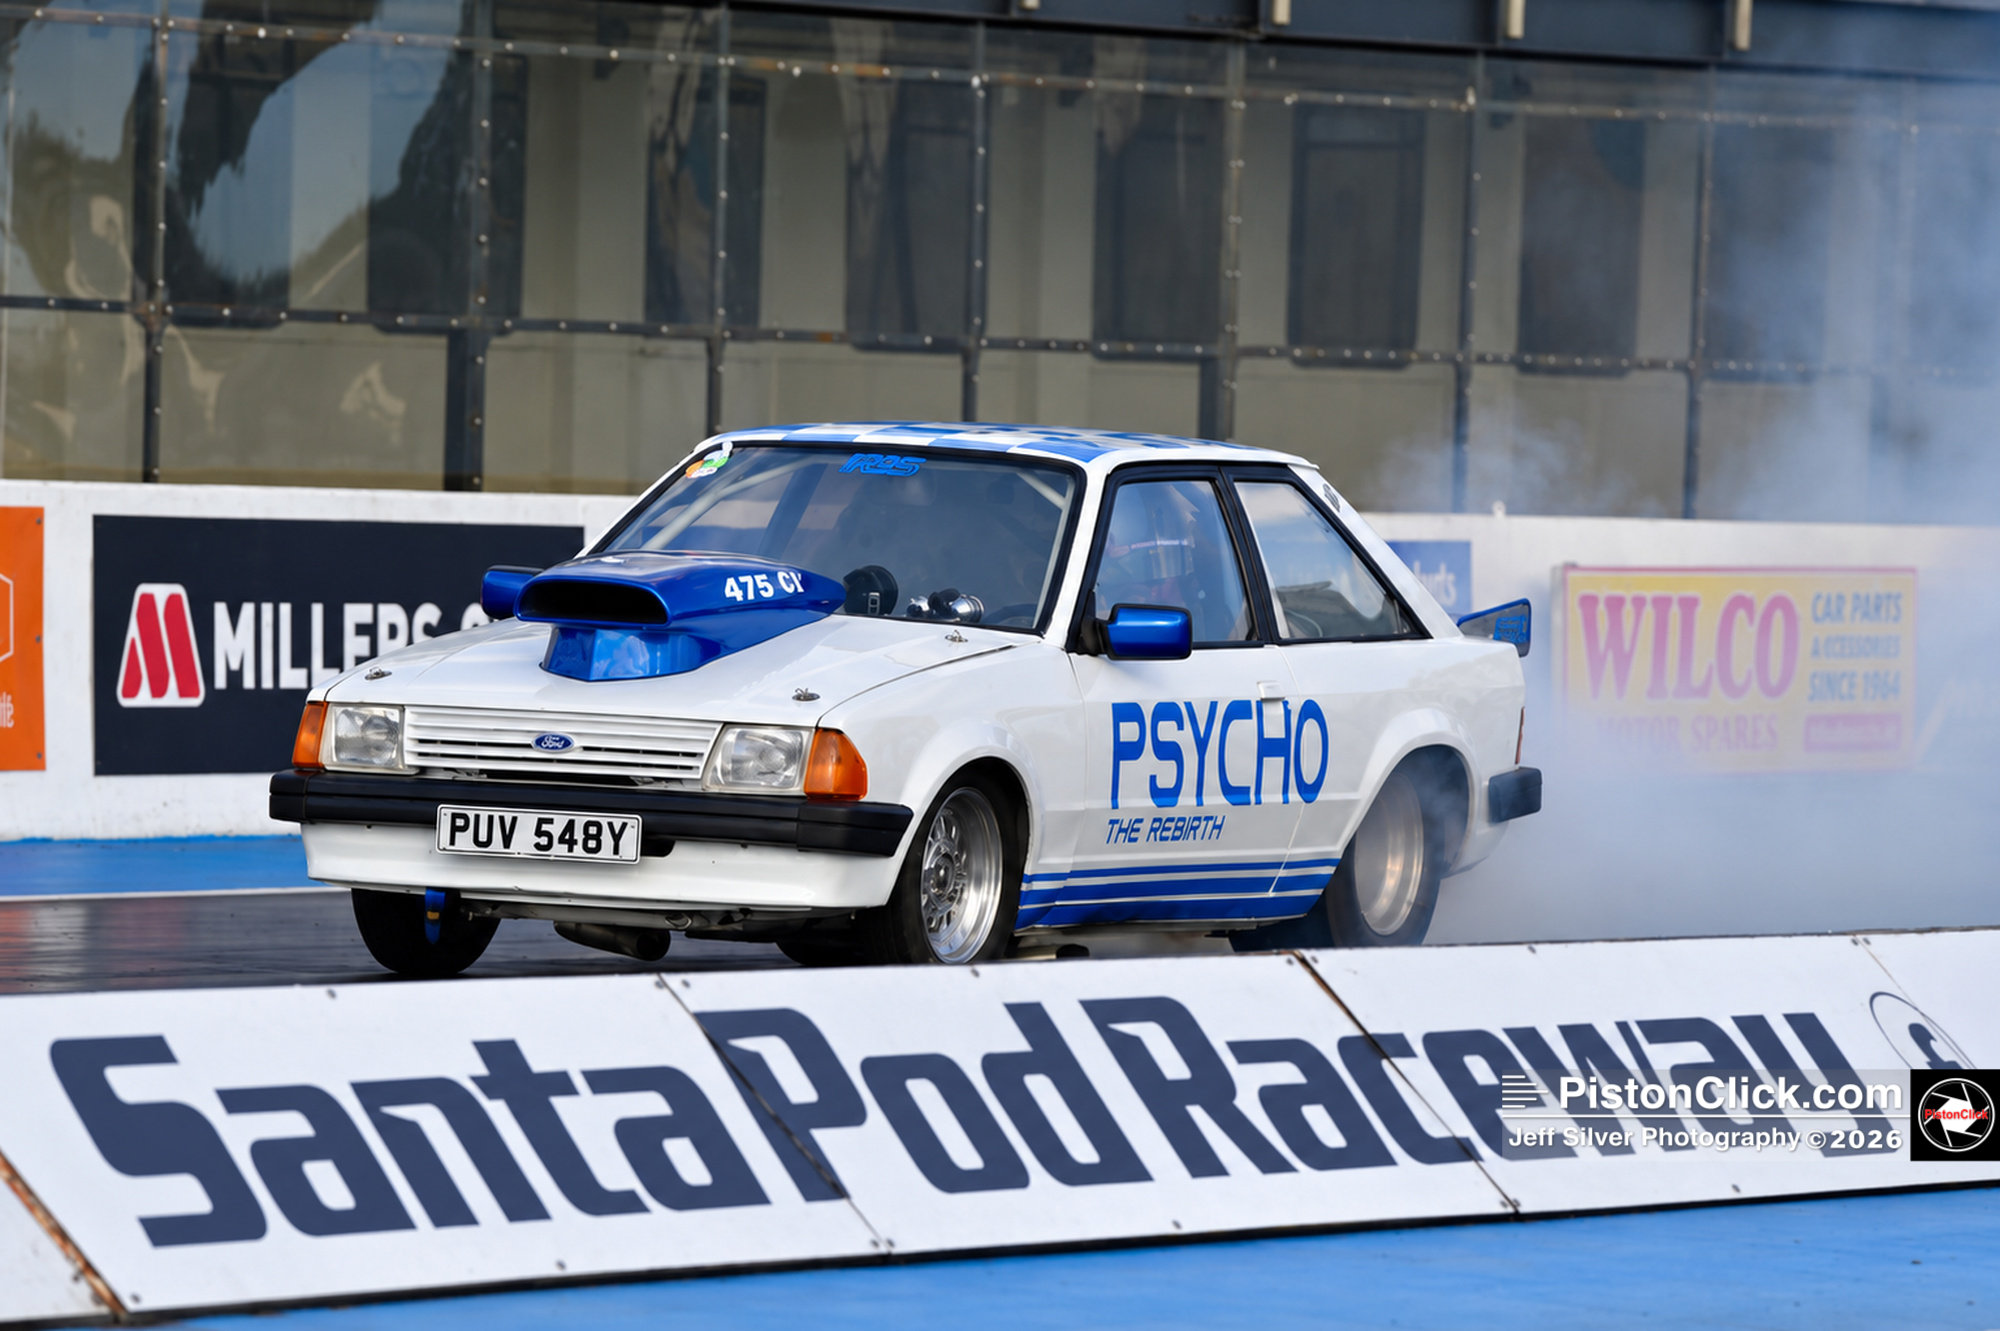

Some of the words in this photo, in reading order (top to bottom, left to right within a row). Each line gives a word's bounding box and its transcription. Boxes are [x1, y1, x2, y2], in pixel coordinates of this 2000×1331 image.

[724, 573, 774, 602] 475
[1811, 592, 1846, 624] CAR
[1850, 591, 1903, 623] PARTS
[1577, 593, 1799, 700] WILCO
[1808, 670, 1857, 702] SINCE
[1110, 699, 1329, 809] PSYCHO
[449, 812, 518, 850] PUV
[533, 817, 628, 856] 548Y
[1106, 818, 1144, 844] THE
[1146, 815, 1226, 843] REBIRTH
[50, 1035, 771, 1247] Santa
[691, 1002, 1153, 1201] Pod
